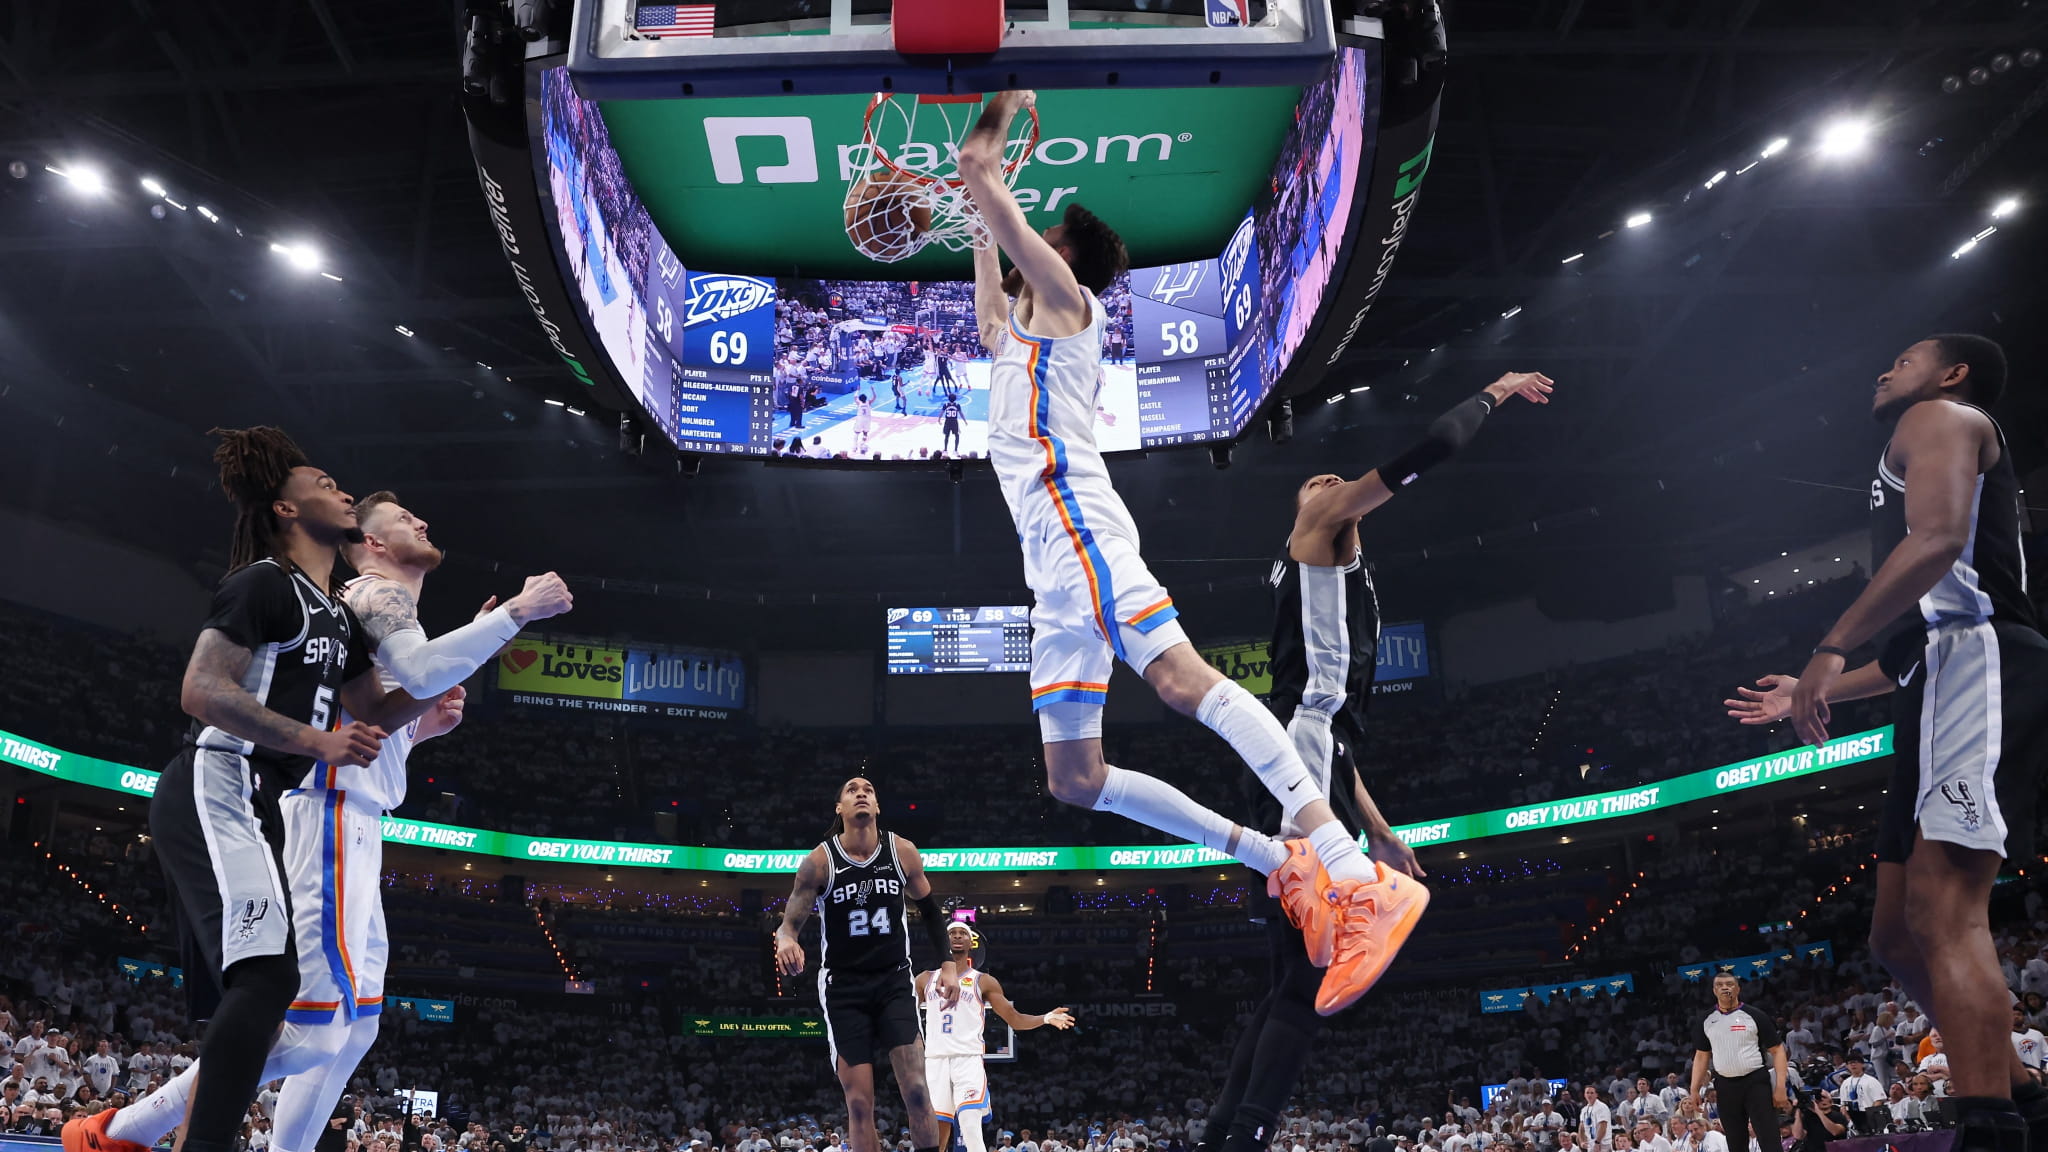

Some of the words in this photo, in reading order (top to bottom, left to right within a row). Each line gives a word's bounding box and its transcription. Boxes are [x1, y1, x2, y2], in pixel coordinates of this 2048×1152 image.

[482, 166, 520, 255] center
[1365, 191, 1417, 299] paycom
[511, 261, 575, 357] paycom
[1235, 283, 1252, 331] 69
[656, 295, 673, 344] 58
[710, 331, 748, 366] 69
[1161, 320, 1199, 357] 58
[684, 369, 707, 378] PLAYER
[1138, 366, 1161, 374] PLAYER
[1204, 358, 1217, 367] PTS
[1209, 370, 1216, 378] 11
[811, 375, 843, 384] coinbase
[682, 393, 707, 401] MCCAIN
[1140, 402, 1162, 410] CASTLE
[1210, 394, 1218, 402] 12
[681, 417, 715, 426] HOLMGREN
[752, 422, 759, 430] 12
[912, 610, 933, 623] 69
[946, 614, 971, 622] 11:36
[985, 609, 1004, 621] 58
[629, 660, 686, 693] LOUD
[694, 660, 740, 701] CITY
[1382, 682, 1413, 694] NOW
[310, 683, 335, 732] 5
[513, 695, 554, 706] BRING
[558, 698, 583, 709] THE
[587, 700, 647, 713] THUNDER
[667, 707, 696, 718] EXIT
[698, 709, 728, 720] NOW
[1715, 763, 1762, 789] OBEY
[1763, 751, 1815, 778] YOUR
[120, 771, 158, 793] OBE
[1505, 806, 1551, 829] OBEY
[1552, 800, 1599, 820] YOUR
[527, 840, 572, 857] OBEY
[571, 843, 616, 861] YOUR
[723, 853, 765, 869] OBEY
[765, 854, 803, 869] YOU
[957, 852, 1001, 867] YOUR
[1110, 850, 1151, 866] OBEY
[1151, 849, 1195, 865] YOUR
[833, 878, 899, 906] SPURS
[848, 907, 891, 937] 24
[719, 1023, 735, 1031] LIVE
[941, 1014, 953, 1034] 2
[414, 1098, 433, 1107] TRA
